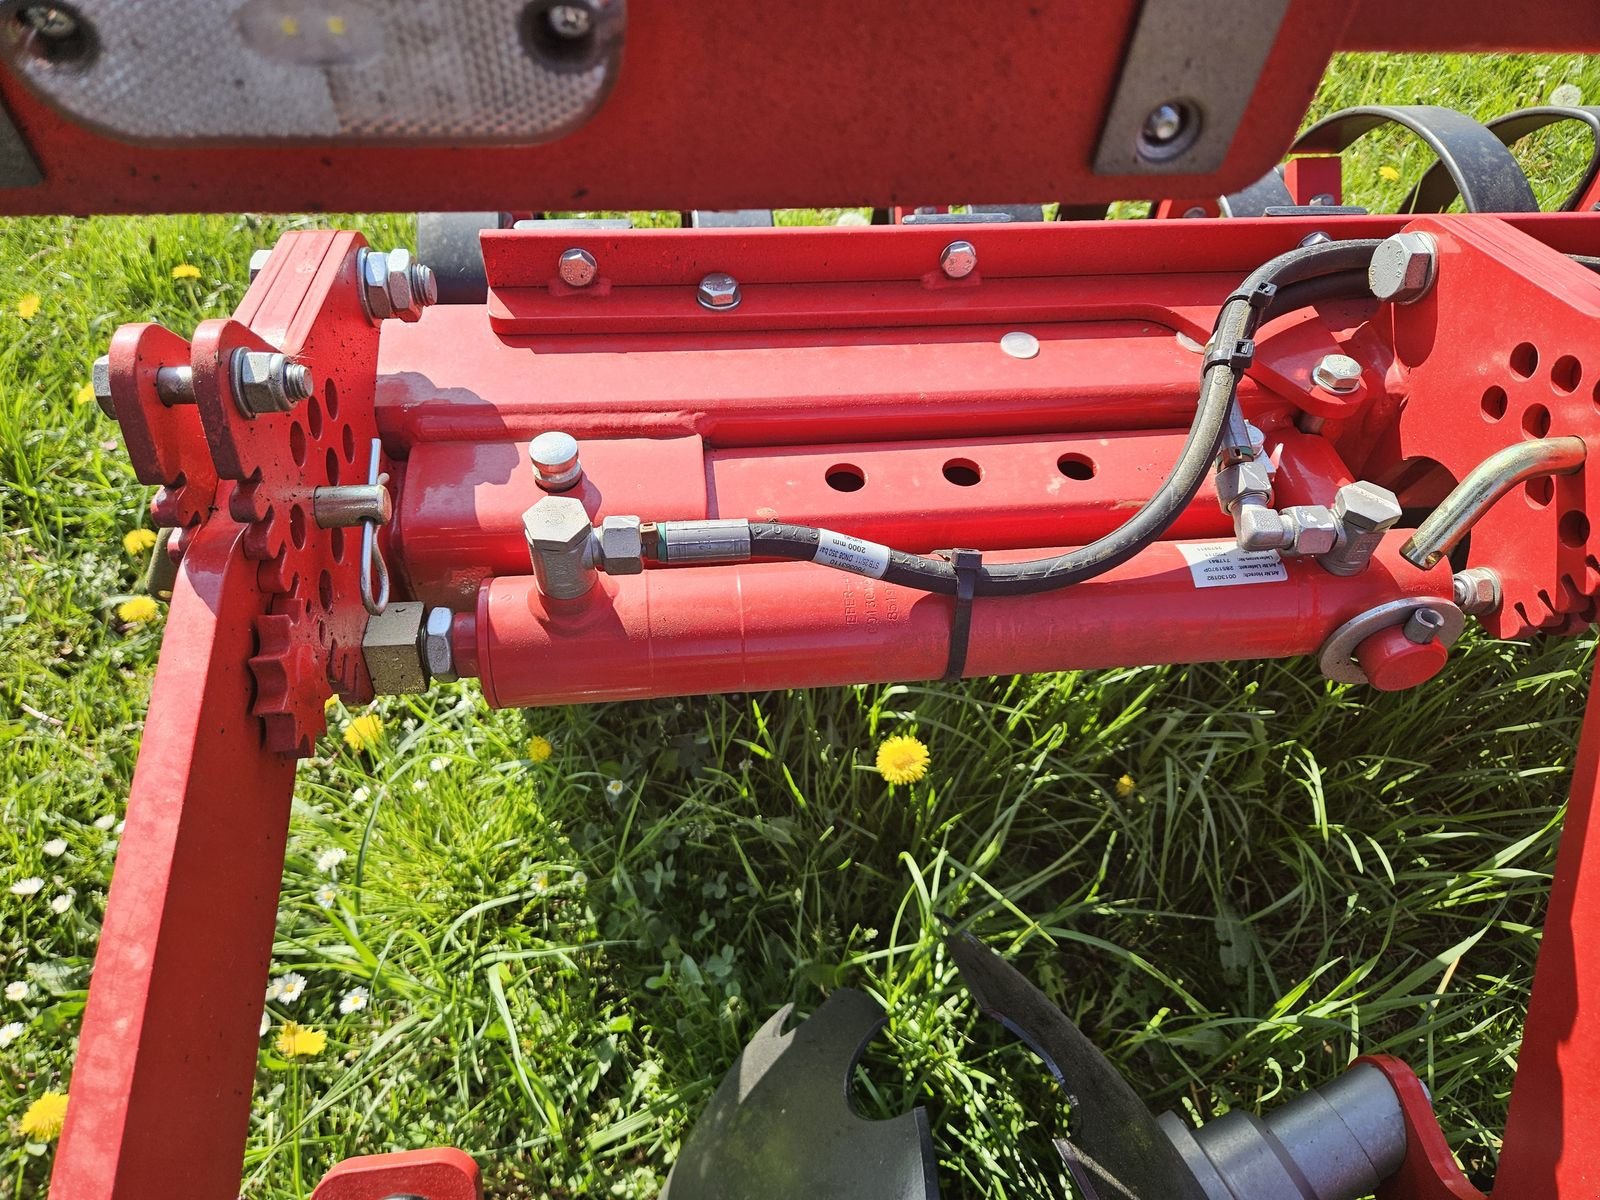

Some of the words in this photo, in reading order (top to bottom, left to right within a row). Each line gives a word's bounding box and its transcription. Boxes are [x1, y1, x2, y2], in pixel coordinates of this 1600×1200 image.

[833, 539, 846, 547] mm
[819, 546, 828, 555] bar
[848, 544, 866, 554] 2000
[869, 560, 880, 569] STB
[1207, 573, 1237, 581] 00130192
